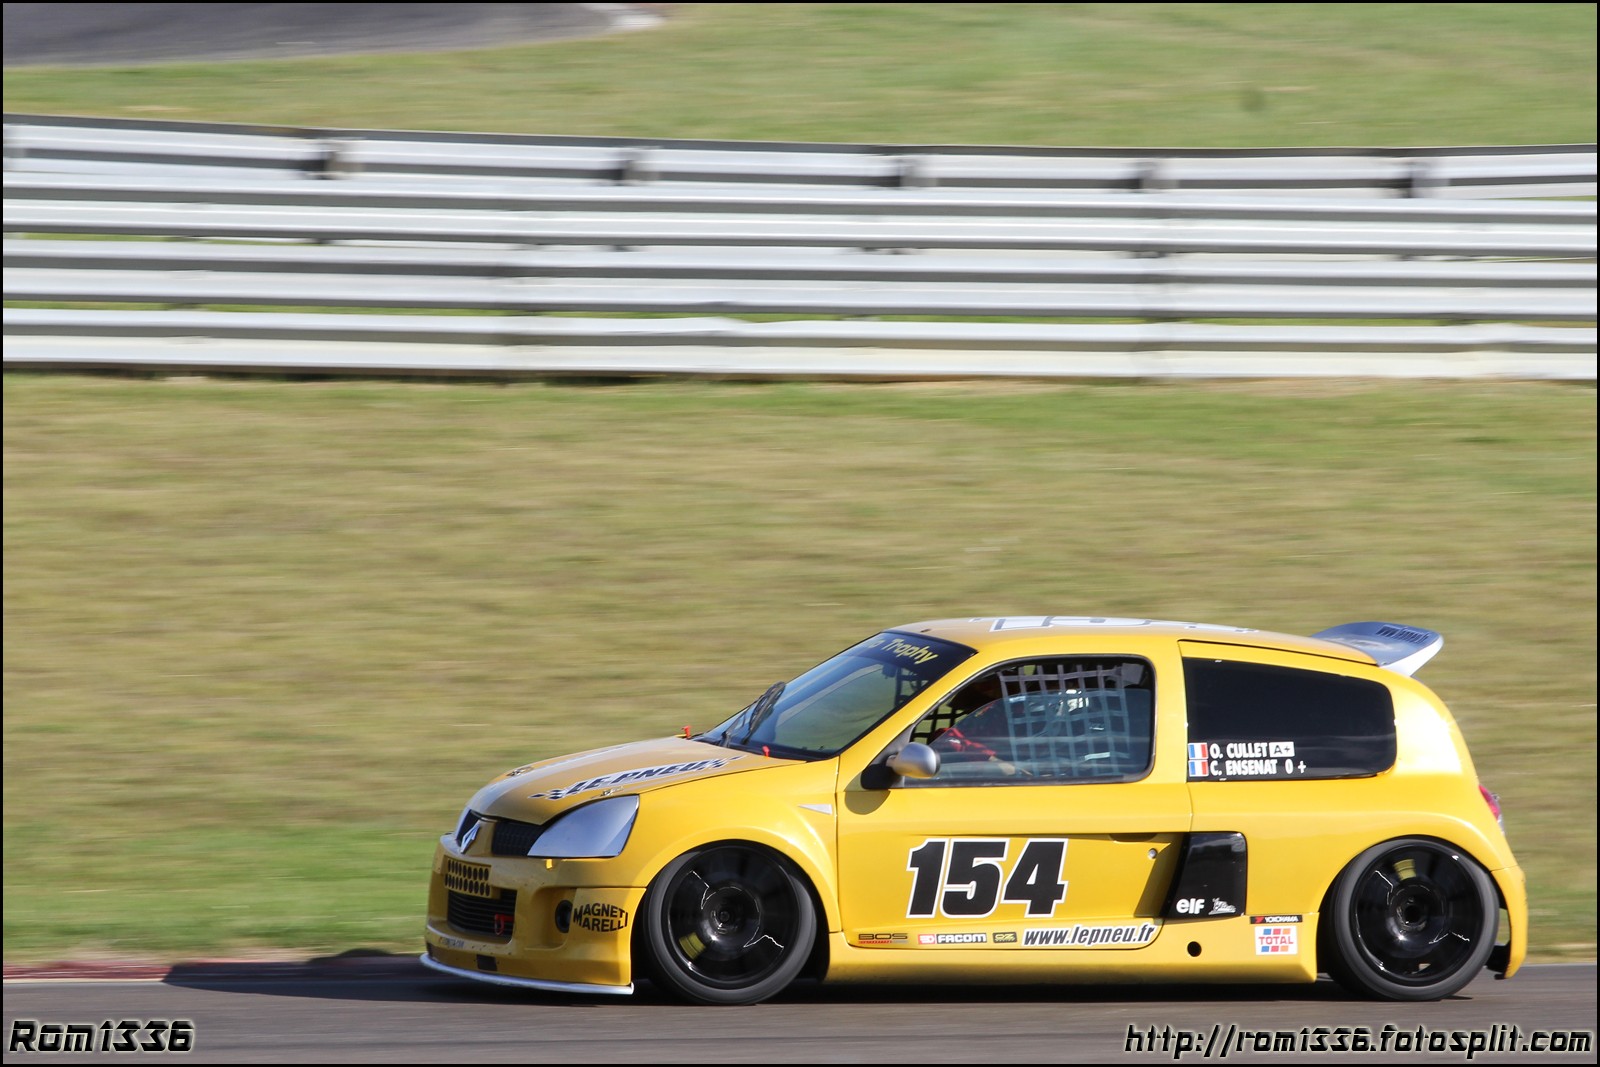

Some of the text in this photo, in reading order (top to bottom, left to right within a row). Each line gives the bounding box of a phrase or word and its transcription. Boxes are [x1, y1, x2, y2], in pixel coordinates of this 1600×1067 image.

[881, 638, 939, 665] Trophy
[1210, 743, 1223, 759] O.
[1226, 742, 1268, 759] CULLET
[1210, 760, 1223, 776] C.
[1225, 759, 1278, 775] ENSENAT
[906, 838, 1069, 918] 154
[573, 903, 628, 922] MAGNETI
[1176, 898, 1205, 914] elf
[573, 910, 628, 932] MARELLI
[937, 933, 987, 943] FACOM
[1023, 924, 1155, 946] www.lepneu.fr
[1258, 936, 1294, 945] TOTAL
